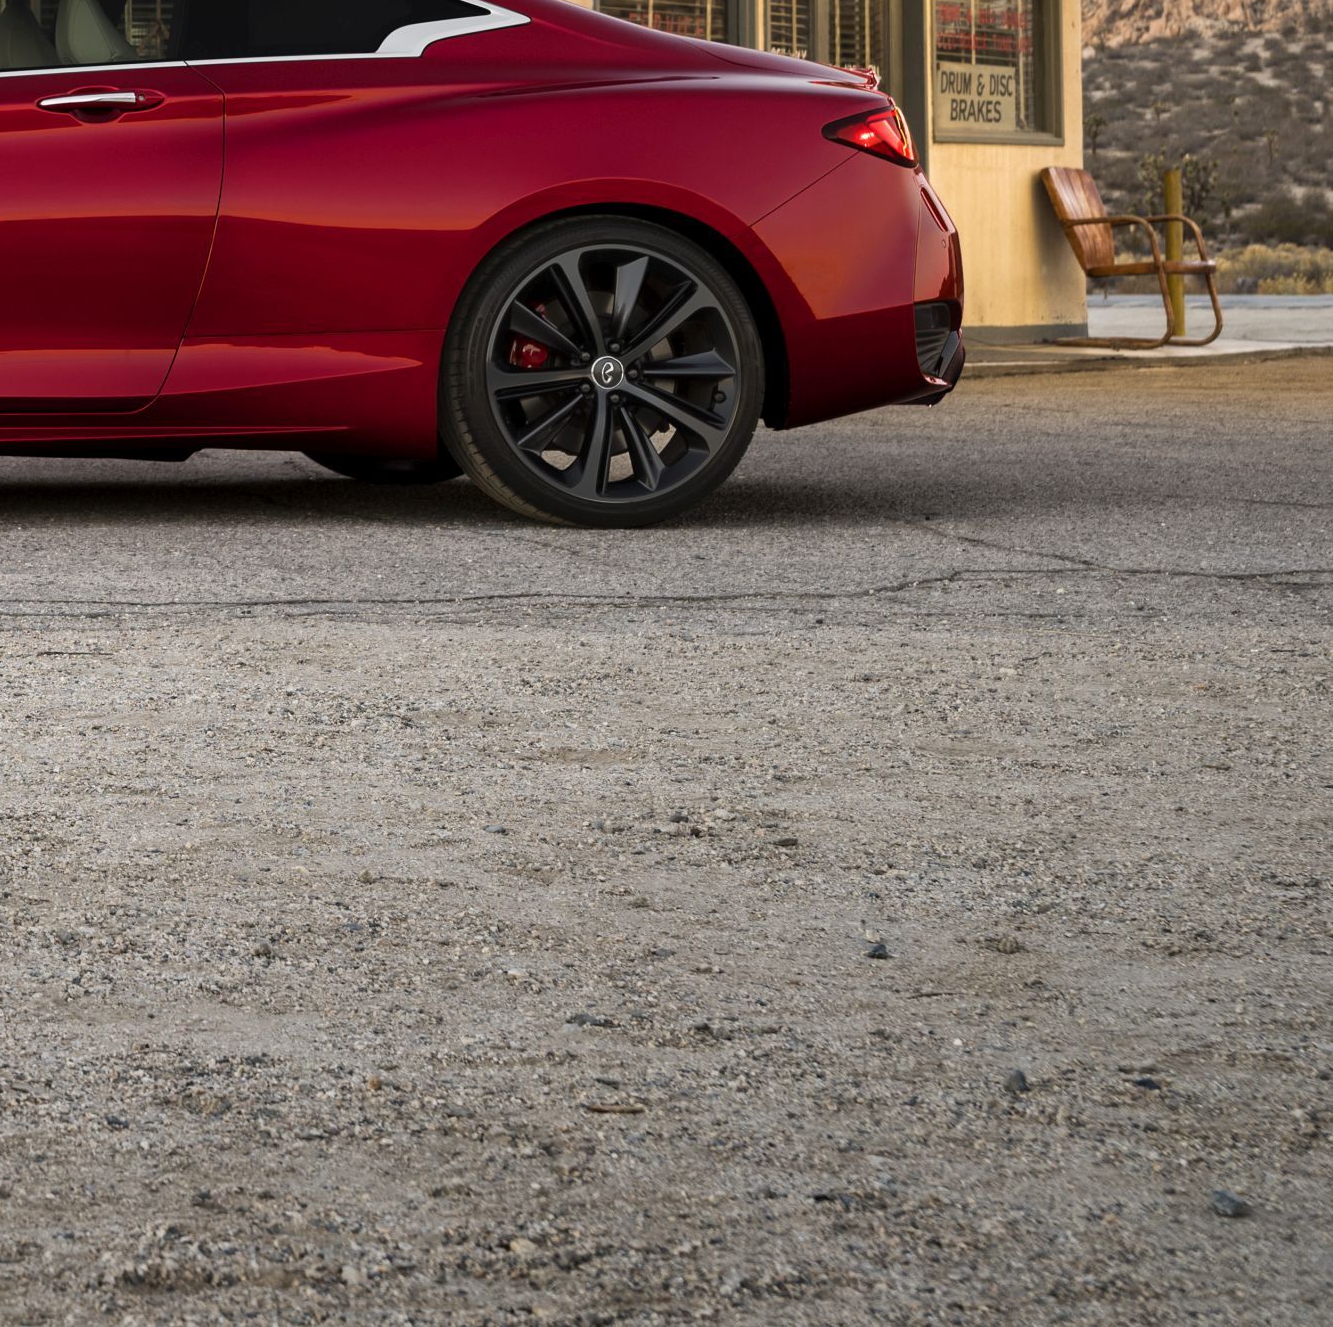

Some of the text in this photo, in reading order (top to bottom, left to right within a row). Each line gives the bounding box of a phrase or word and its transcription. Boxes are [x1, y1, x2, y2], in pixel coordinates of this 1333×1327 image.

[940, 70, 1014, 97] DRUM & DISC
[949, 97, 1003, 123] BRAKES
